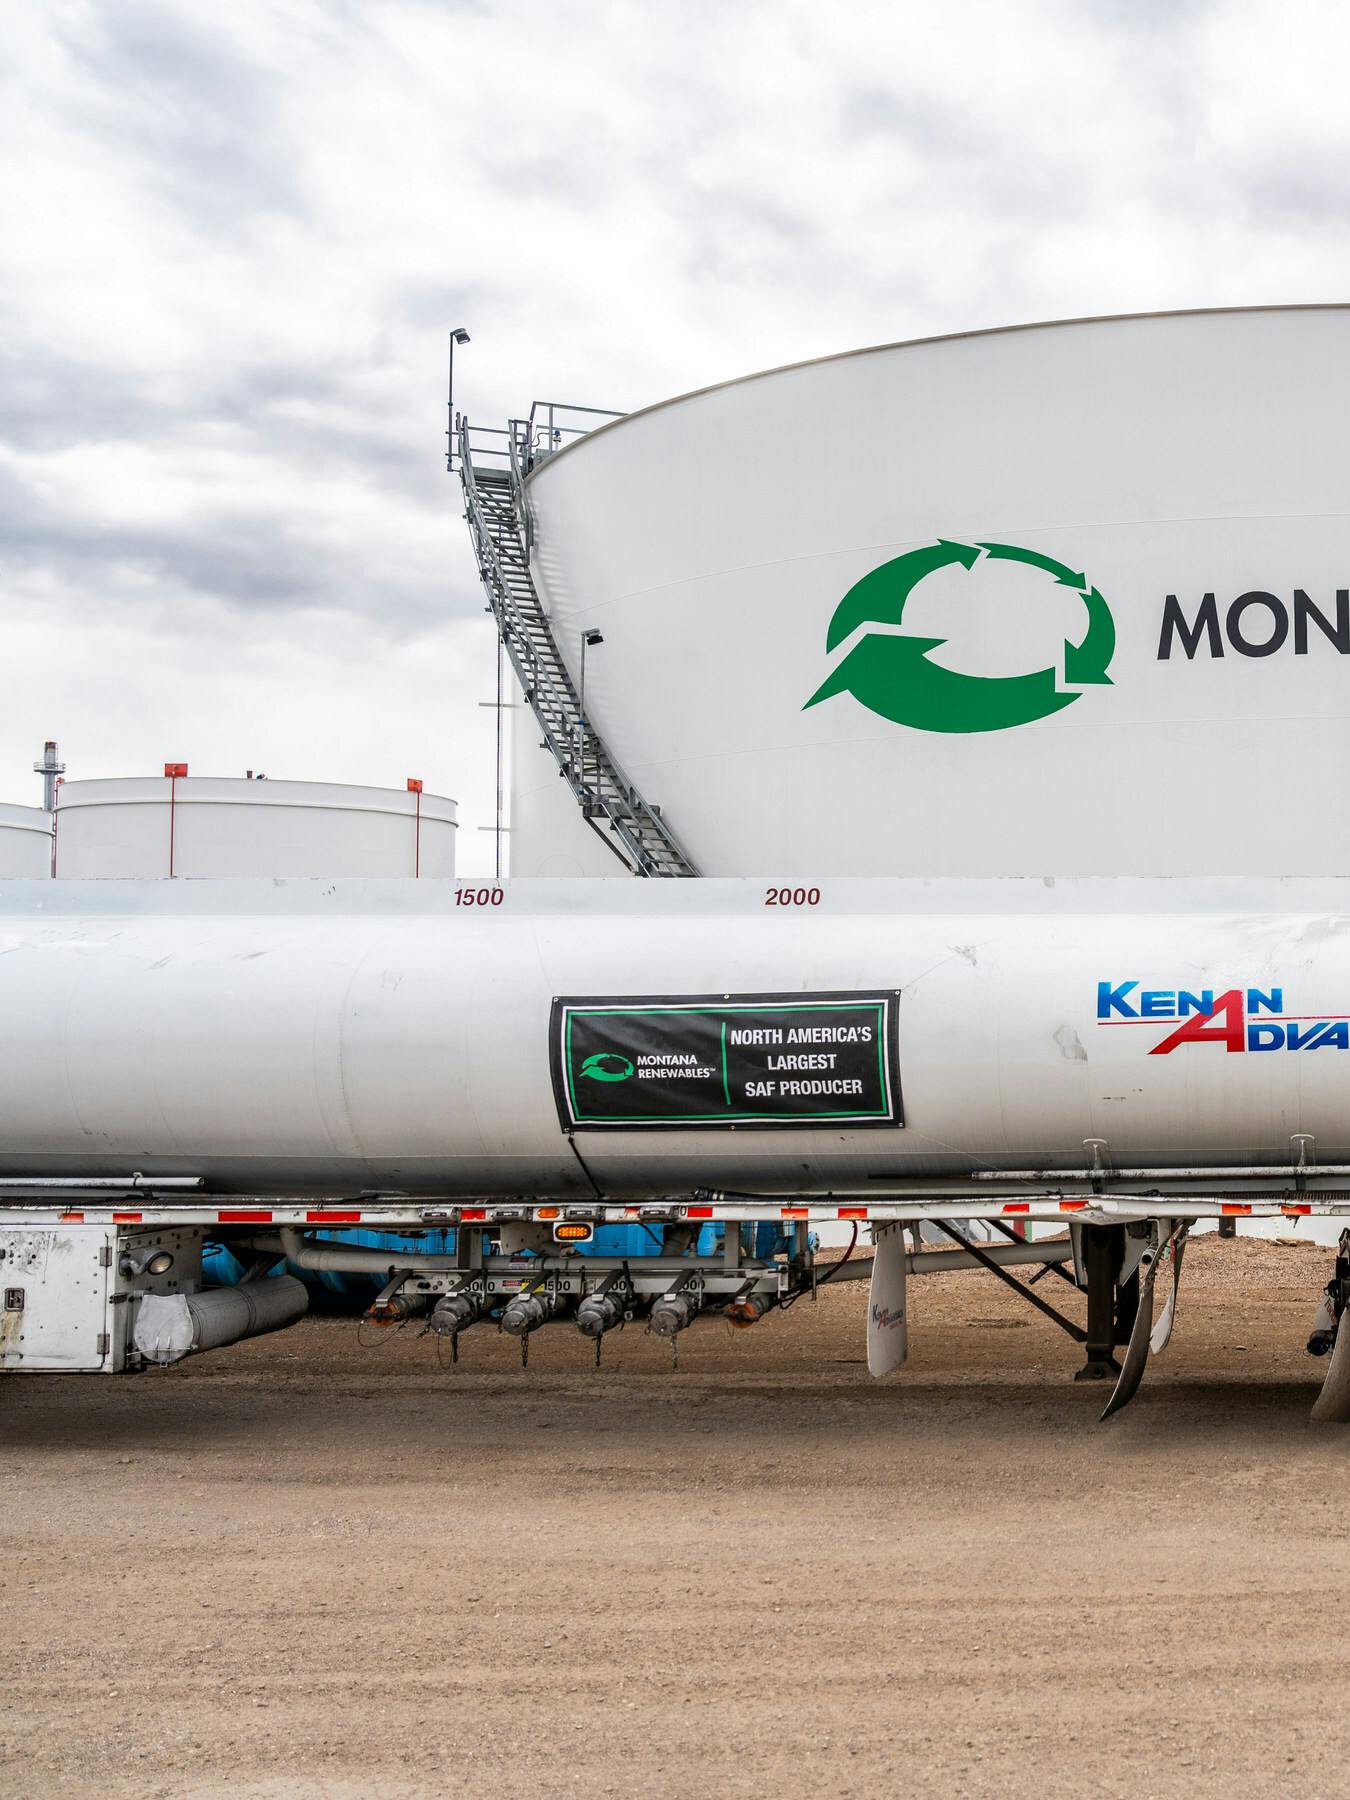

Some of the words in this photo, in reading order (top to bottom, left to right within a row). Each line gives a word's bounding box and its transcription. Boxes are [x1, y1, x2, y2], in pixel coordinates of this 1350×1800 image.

[453, 888, 504, 906] 1500
[765, 888, 821, 906] 2000
[1097, 981, 1283, 1019] KENAN
[730, 1029, 783, 1045] NORTH
[787, 1026, 872, 1044] AMERICA'S
[637, 1054, 698, 1066] MONTANA
[767, 1054, 837, 1071] LARGEST
[744, 1081, 776, 1097] SAF
[780, 1079, 863, 1096] PRODUCER
